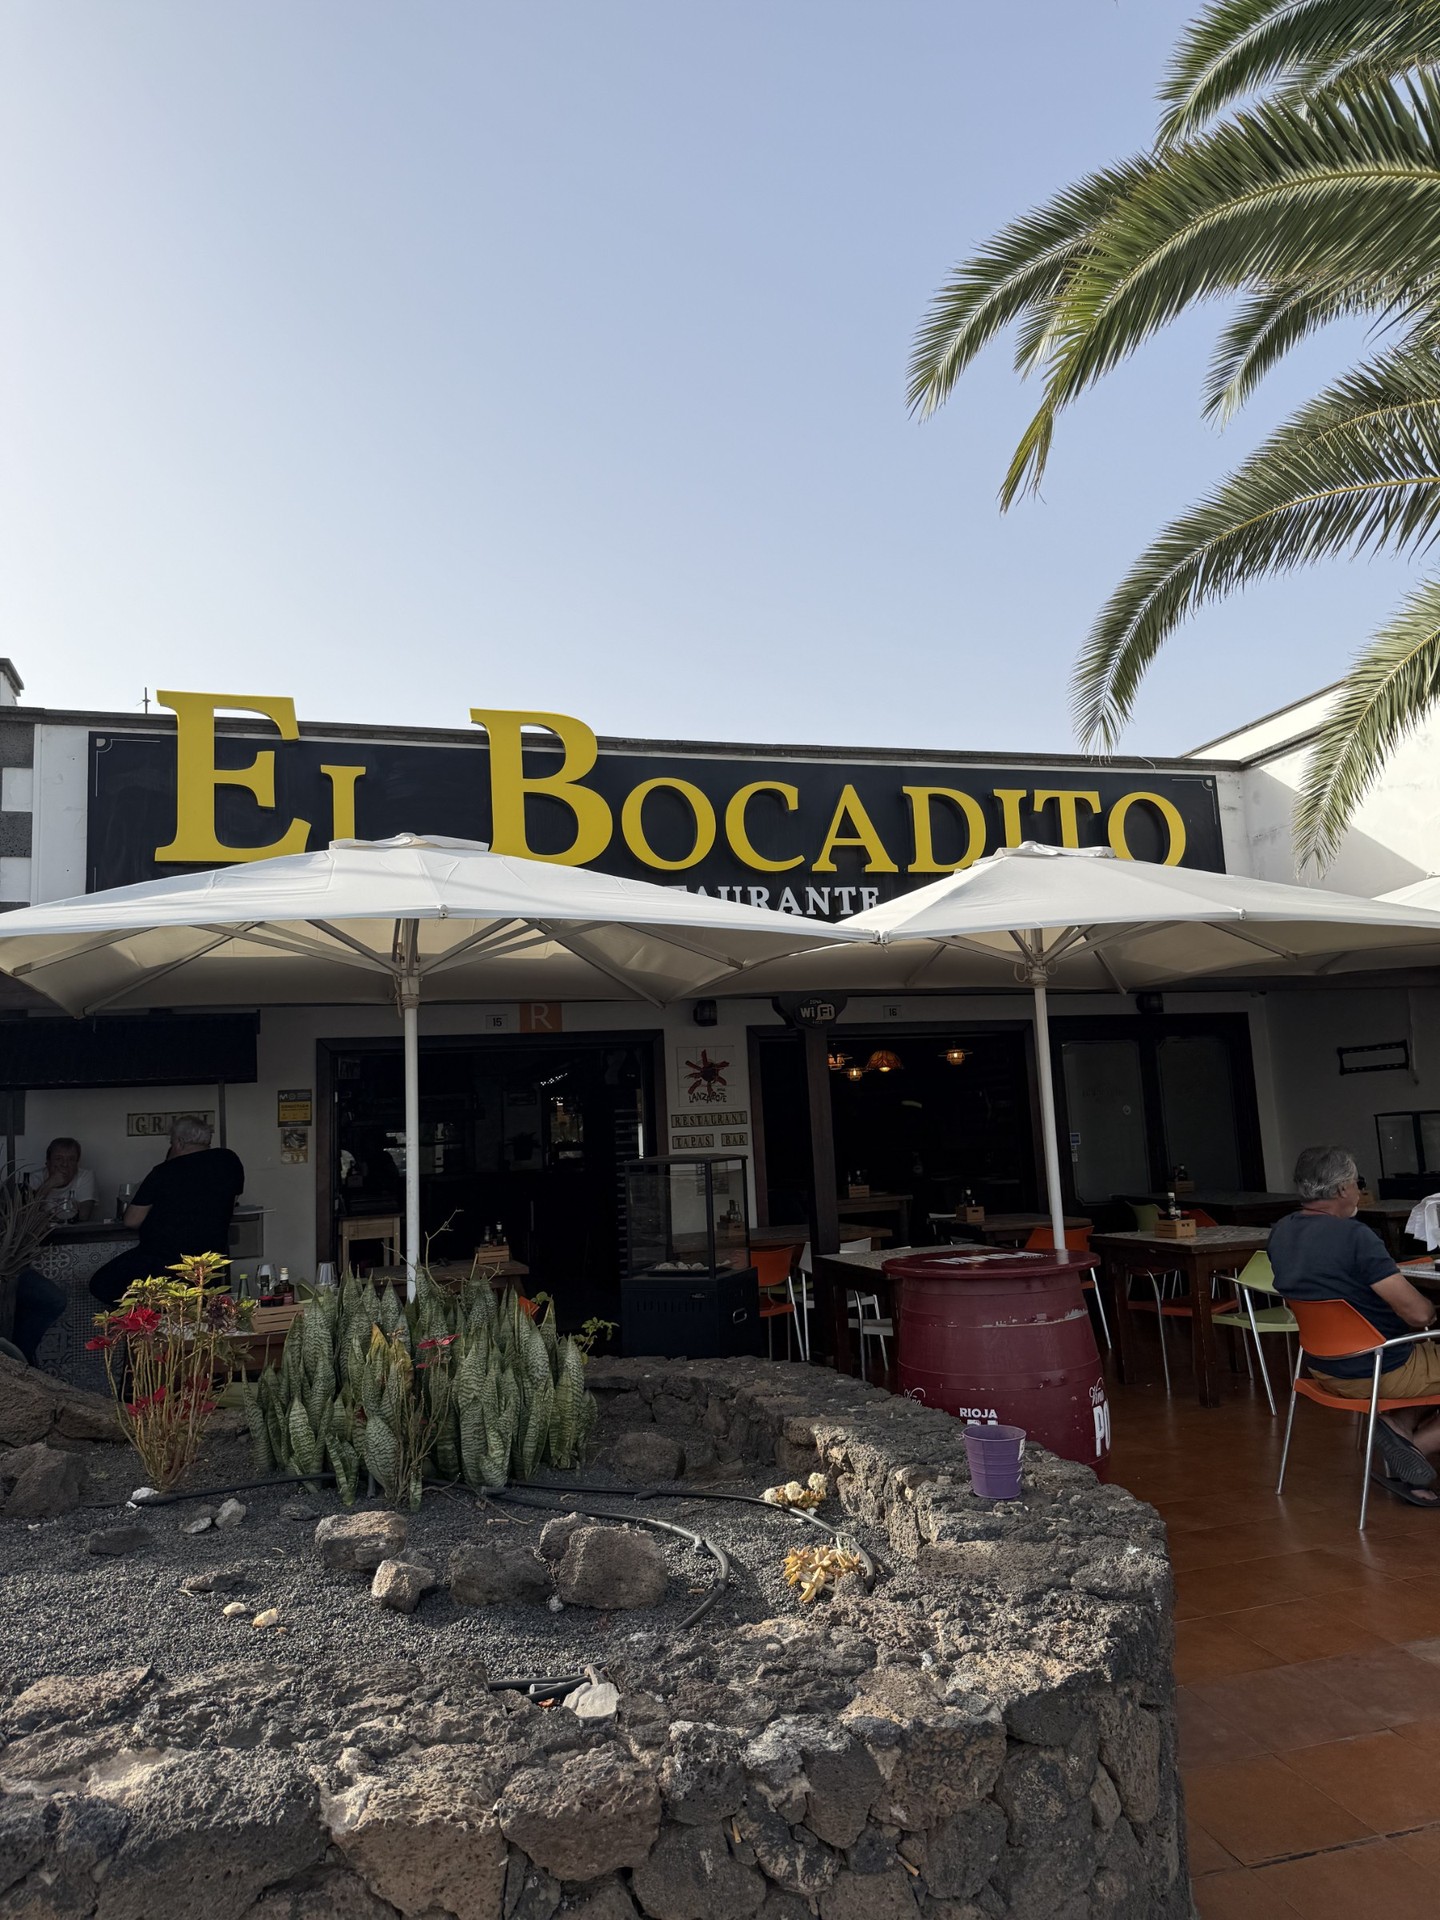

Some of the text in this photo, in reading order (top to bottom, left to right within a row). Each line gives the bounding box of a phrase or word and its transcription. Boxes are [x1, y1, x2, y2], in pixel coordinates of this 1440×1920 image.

[492, 1017, 502, 1027] 15
[530, 1003, 553, 1031] R
[688, 1092, 727, 1104] LANZAROTE
[675, 1113, 745, 1127] RESTAURANT
[677, 1135, 746, 1148] TAPAS BAR
[959, 1408, 998, 1419] RIOJA
